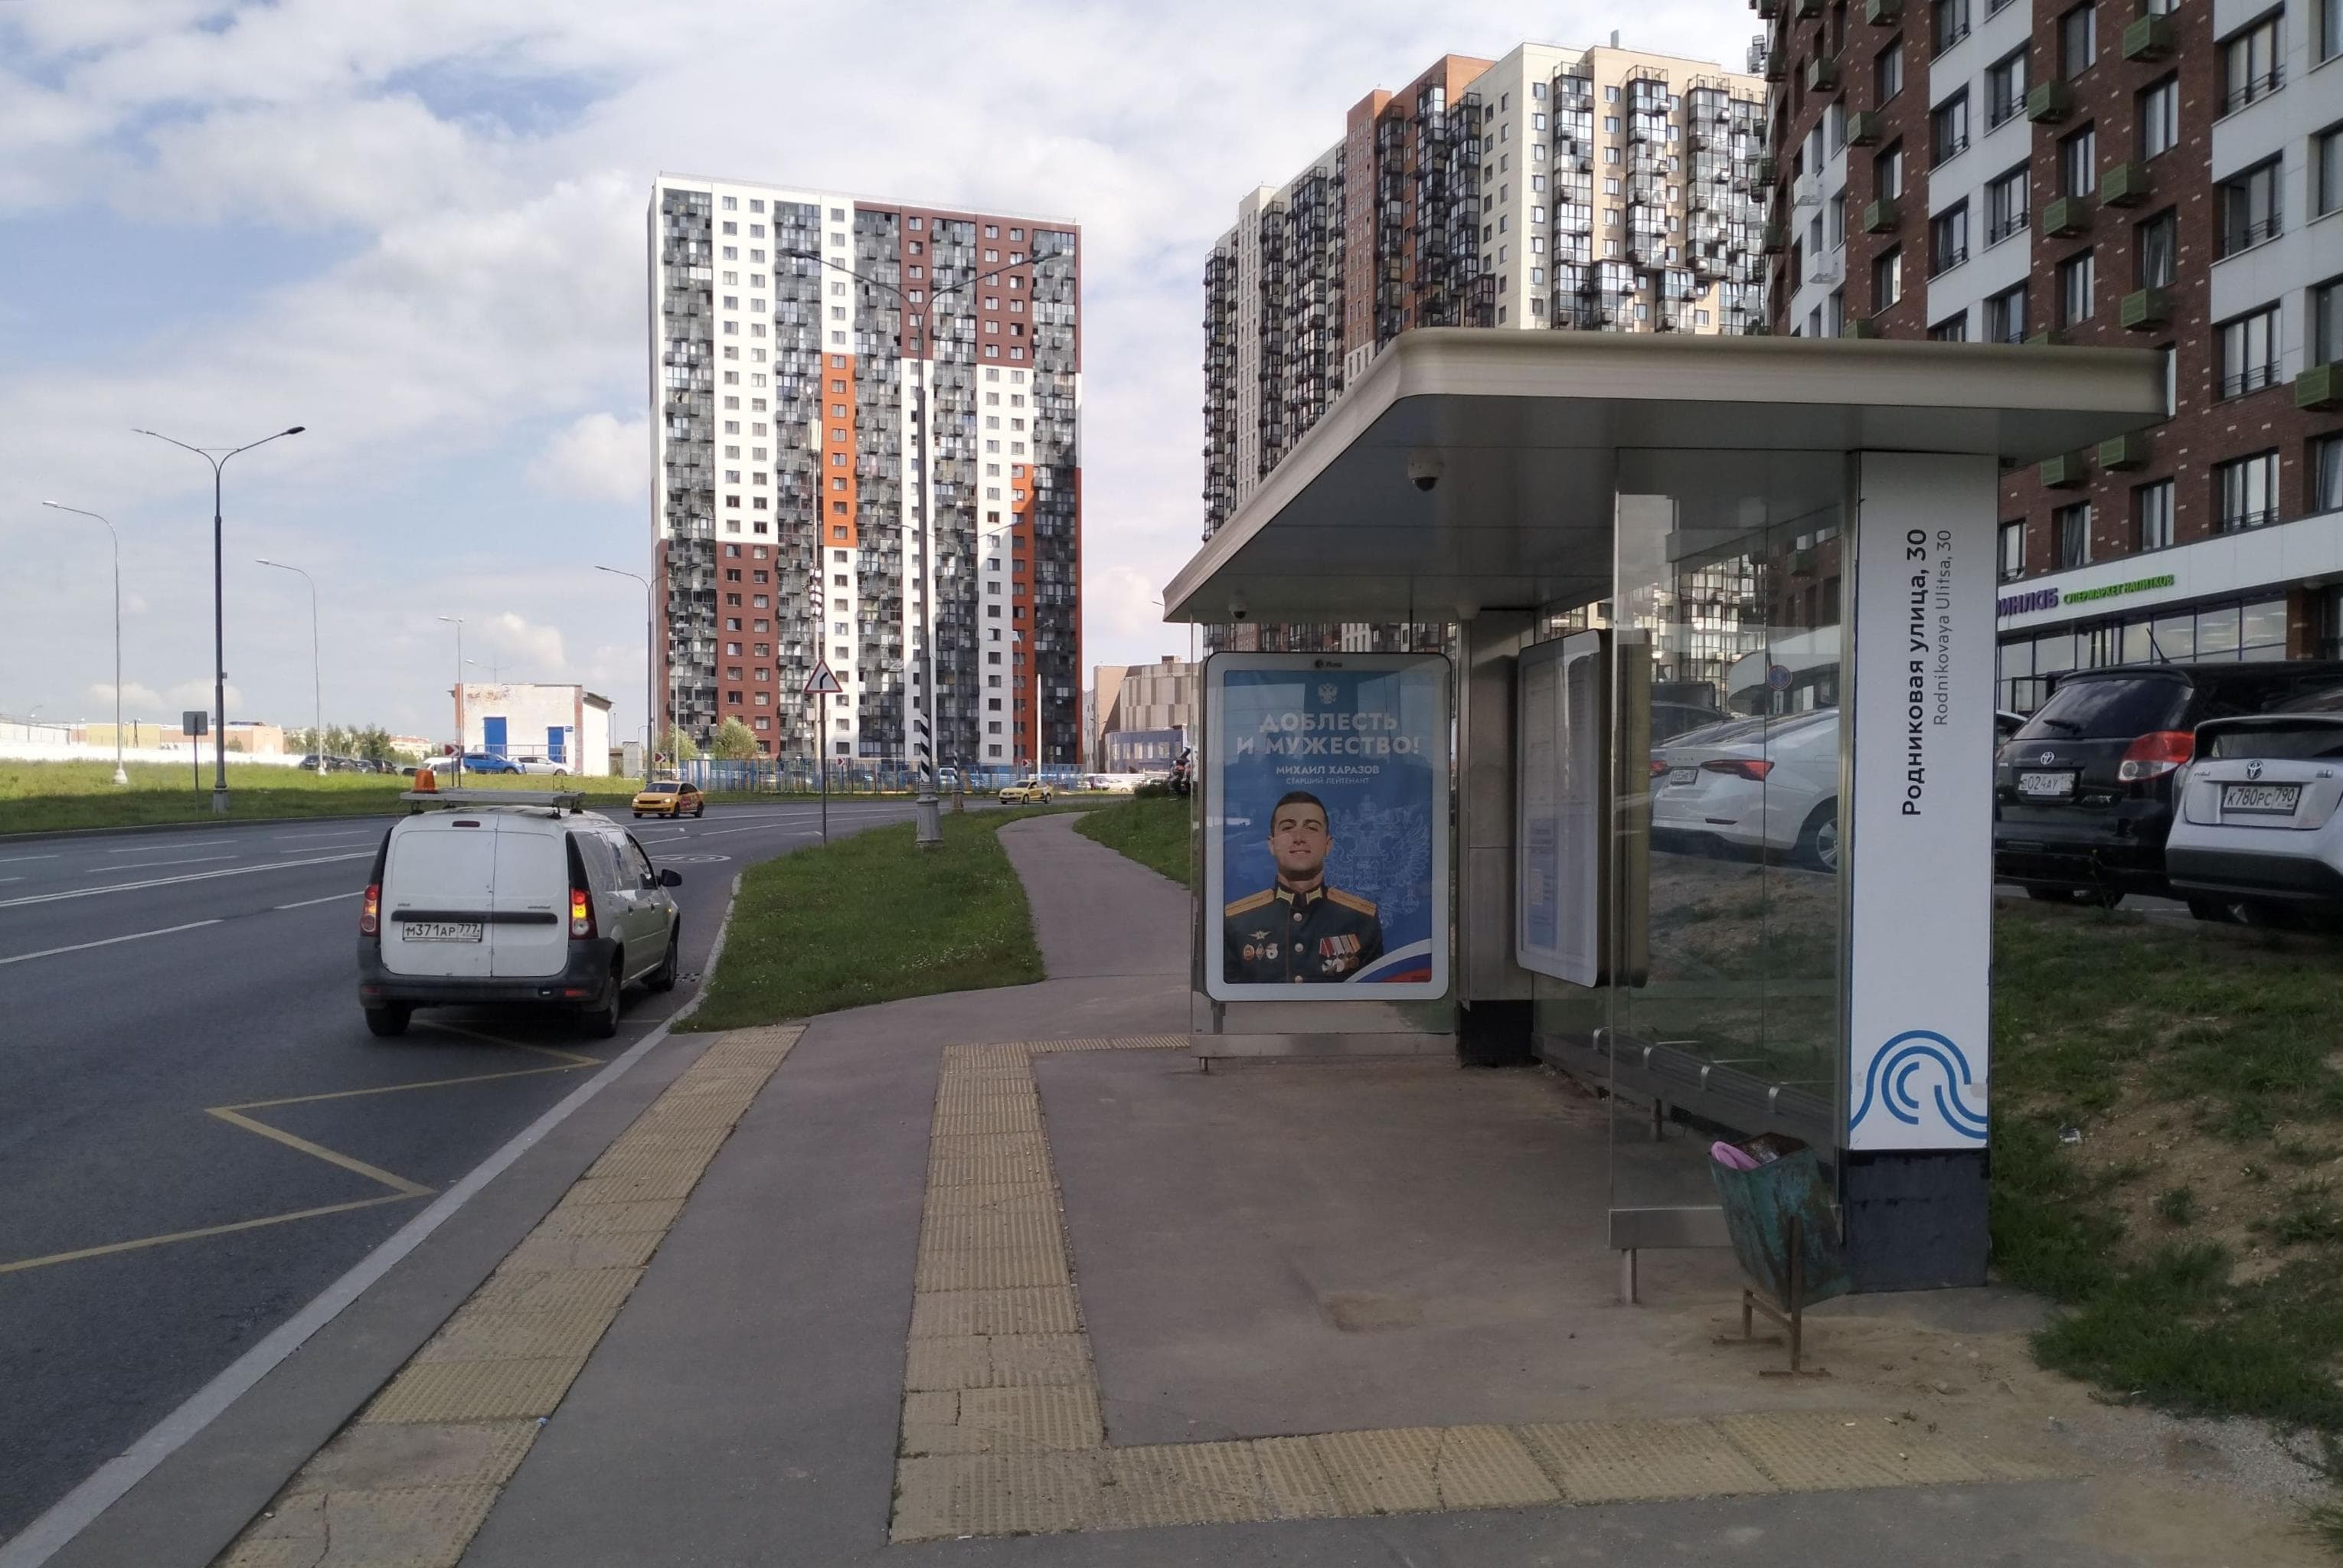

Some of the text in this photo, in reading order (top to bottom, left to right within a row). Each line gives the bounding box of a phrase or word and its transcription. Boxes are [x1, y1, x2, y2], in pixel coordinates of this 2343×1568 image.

[2064, 574, 2175, 604] СУПЕРМАРКЕТ НАПИТКОВ
[1933, 530, 1953, 725] Rodnikovaya Ulitsa, 30
[1902, 529, 1930, 815] Родниковая улица, 30
[1259, 712, 1397, 733] ДОБЛЕСТЬ
[1237, 736, 1420, 755] И МУЖЕСТВО!
[1276, 766, 1381, 775] МИХАИЛ ХАРАЗОВ
[1286, 776, 1370, 785] СТАРШИЙ ЛЕЙТЕНАНТ
[2276, 787, 2295, 802] 790
[459, 923, 477, 934] 777
